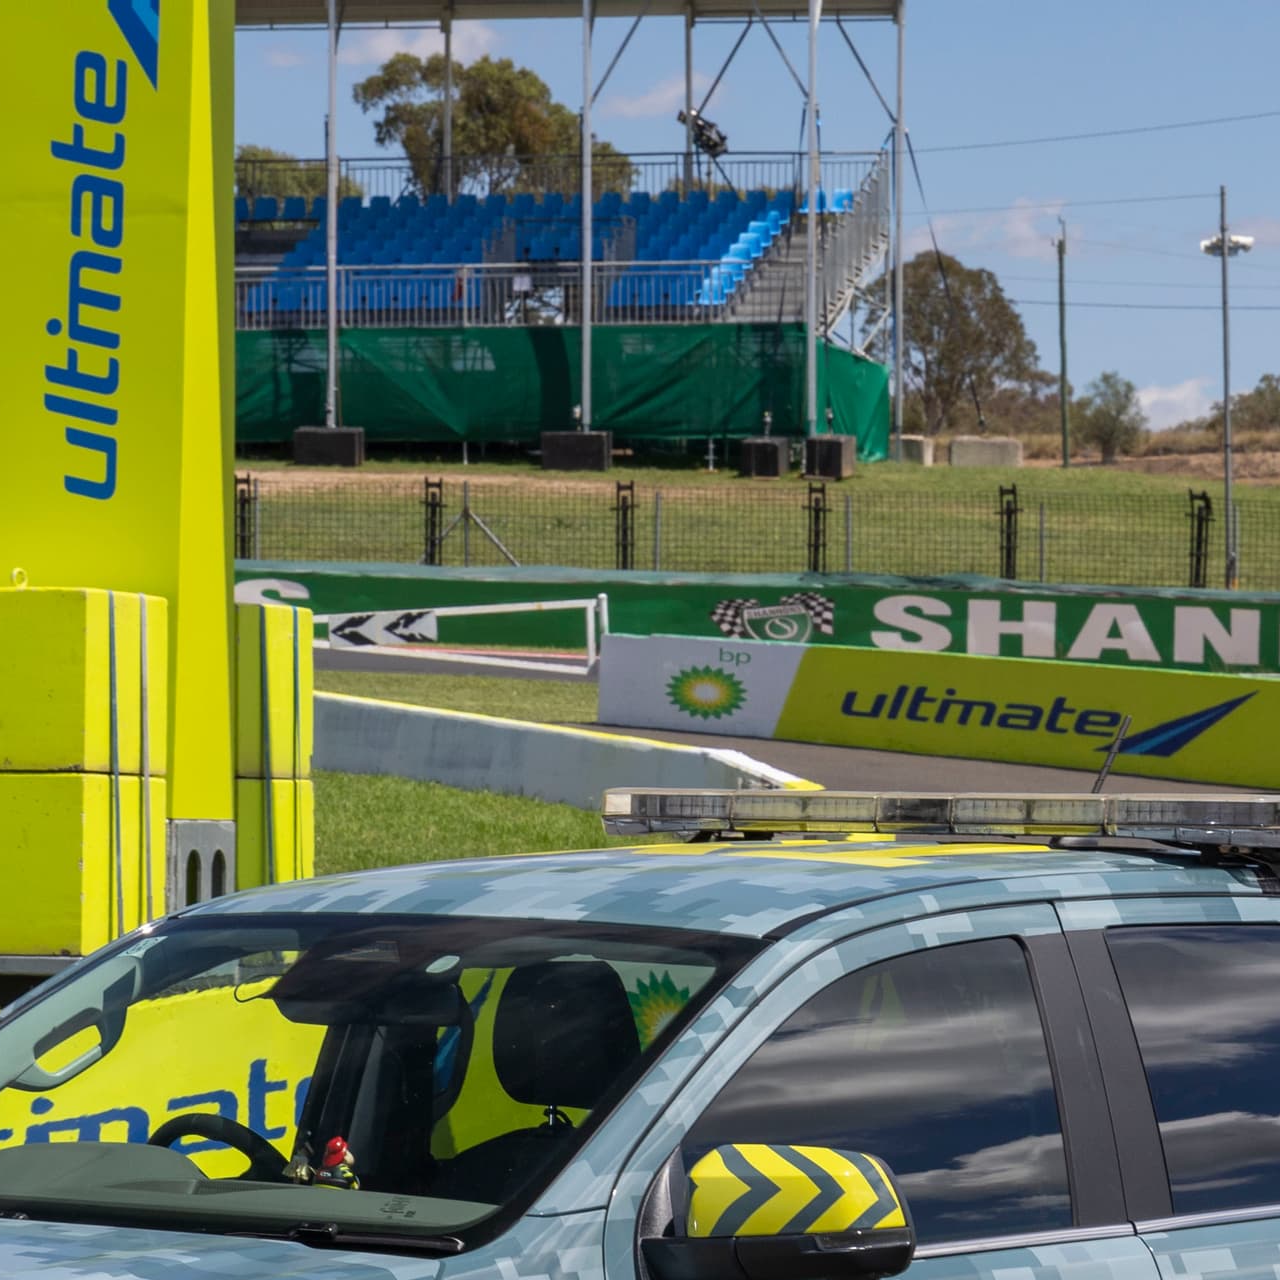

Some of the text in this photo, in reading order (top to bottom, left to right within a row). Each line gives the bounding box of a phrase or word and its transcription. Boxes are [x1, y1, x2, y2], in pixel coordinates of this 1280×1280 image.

[43, 50, 128, 501] ultimate
[719, 648, 752, 666] bp
[841, 684, 1122, 738] ultimate
